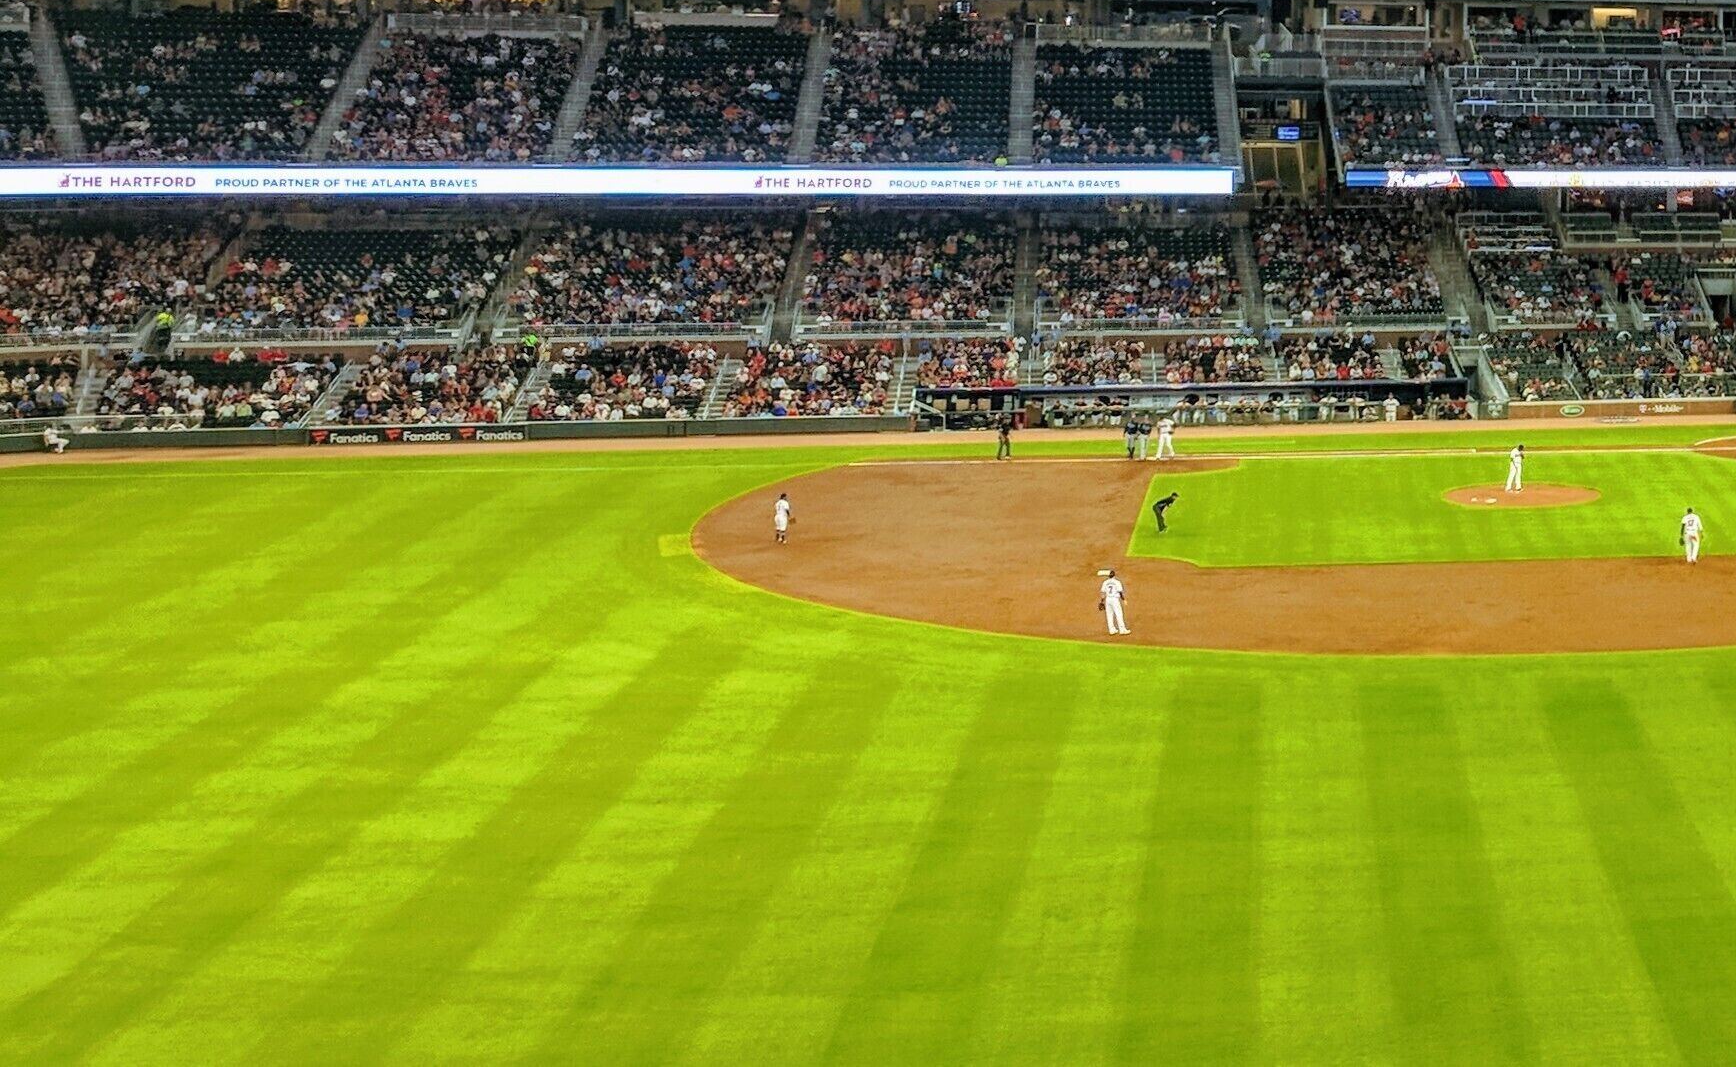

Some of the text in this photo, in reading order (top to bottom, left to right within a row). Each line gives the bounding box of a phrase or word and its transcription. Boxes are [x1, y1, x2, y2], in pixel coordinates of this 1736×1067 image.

[72, 176, 196, 187] THE HARTFORD
[215, 178, 478, 188] PROUD PARTNER OF THE ATLANTA BRAVES
[765, 178, 873, 188] THE HARTFORD
[889, 180, 928, 188] PROUD
[931, 180, 981, 189] PARTNER
[1003, 180, 1023, 189] THE
[1026, 180, 1075, 189] ATLANTA
[1078, 180, 1121, 189] BRAVES
[329, 433, 379, 444] Fanatics
[402, 431, 451, 442] Fanatics
[475, 430, 524, 441] Fanatics
